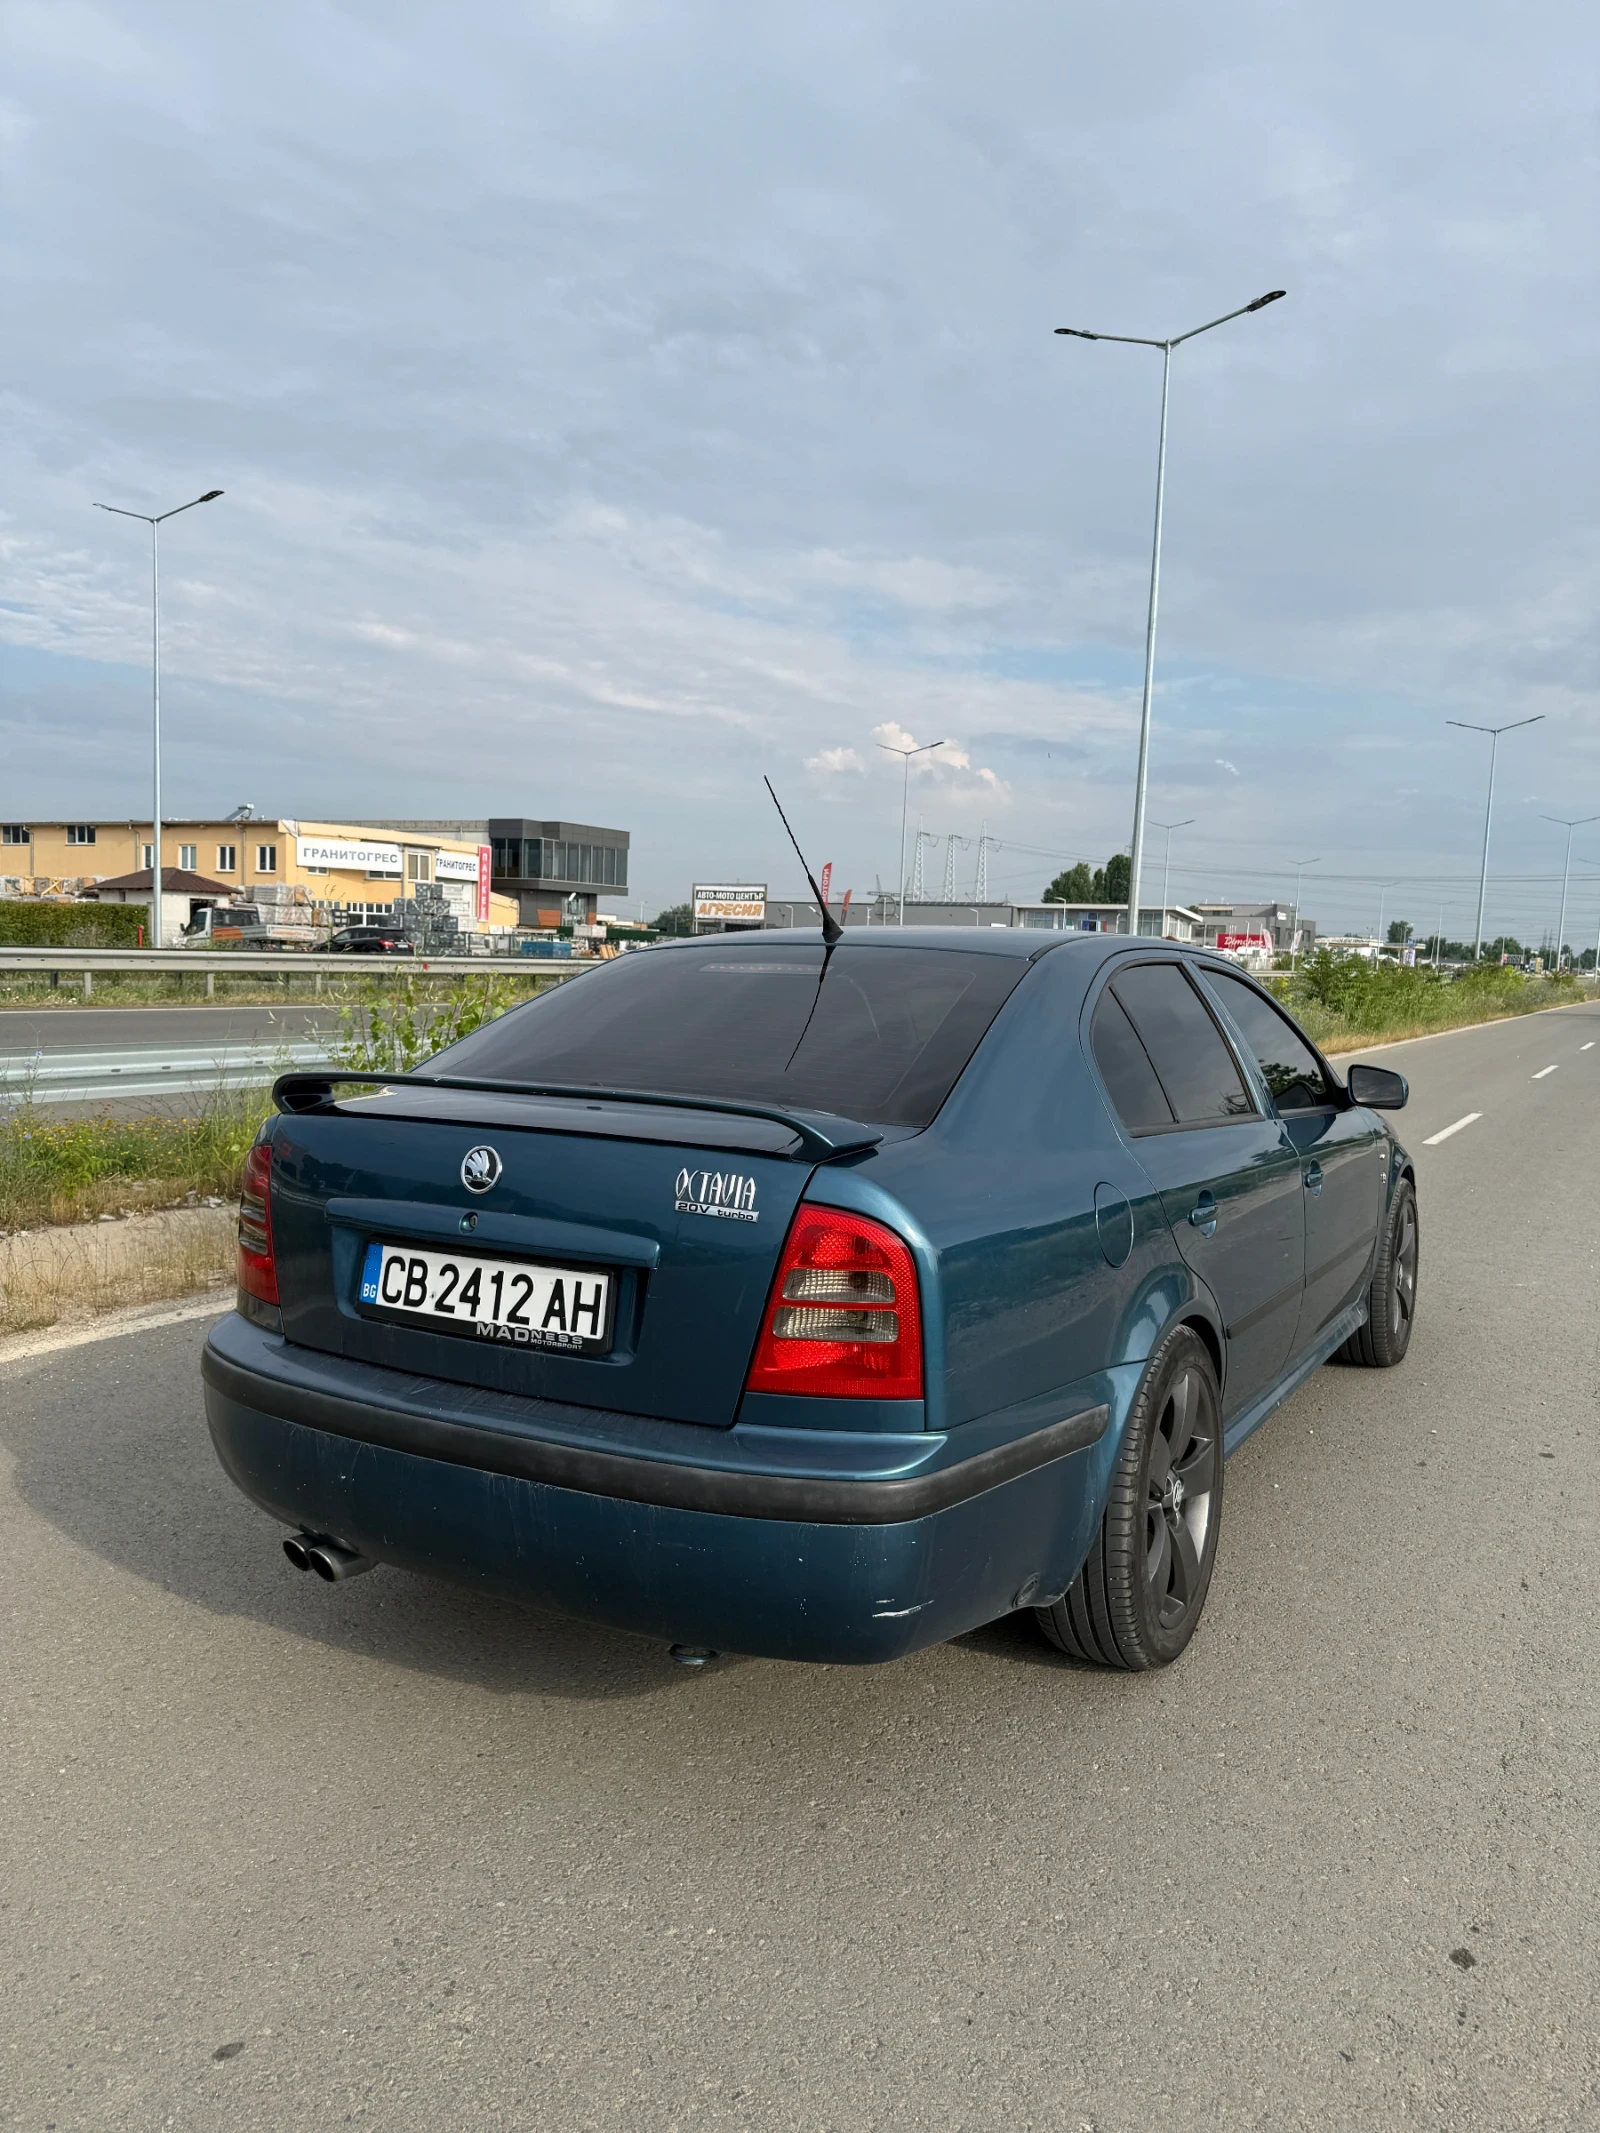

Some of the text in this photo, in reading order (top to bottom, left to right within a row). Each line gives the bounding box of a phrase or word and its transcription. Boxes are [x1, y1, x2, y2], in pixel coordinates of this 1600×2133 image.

[303, 847, 398, 864] ГРАНИТОГРЕС
[436, 858, 476, 872] ГРАНИТОГРЕС
[697, 891, 764, 900] АВТО-МОТО ЦЕНТЪР
[697, 902, 763, 916] АГРЕСИЯ
[675, 1167, 756, 1210] OCTAVIA
[678, 1202, 754, 1220] 20V turbo
[362, 1283, 377, 1298] BG
[381, 1255, 603, 1336] CB 2412 AH
[476, 1322, 583, 1345] MADNESS
[531, 1339, 583, 1350] MOTORSPORT
